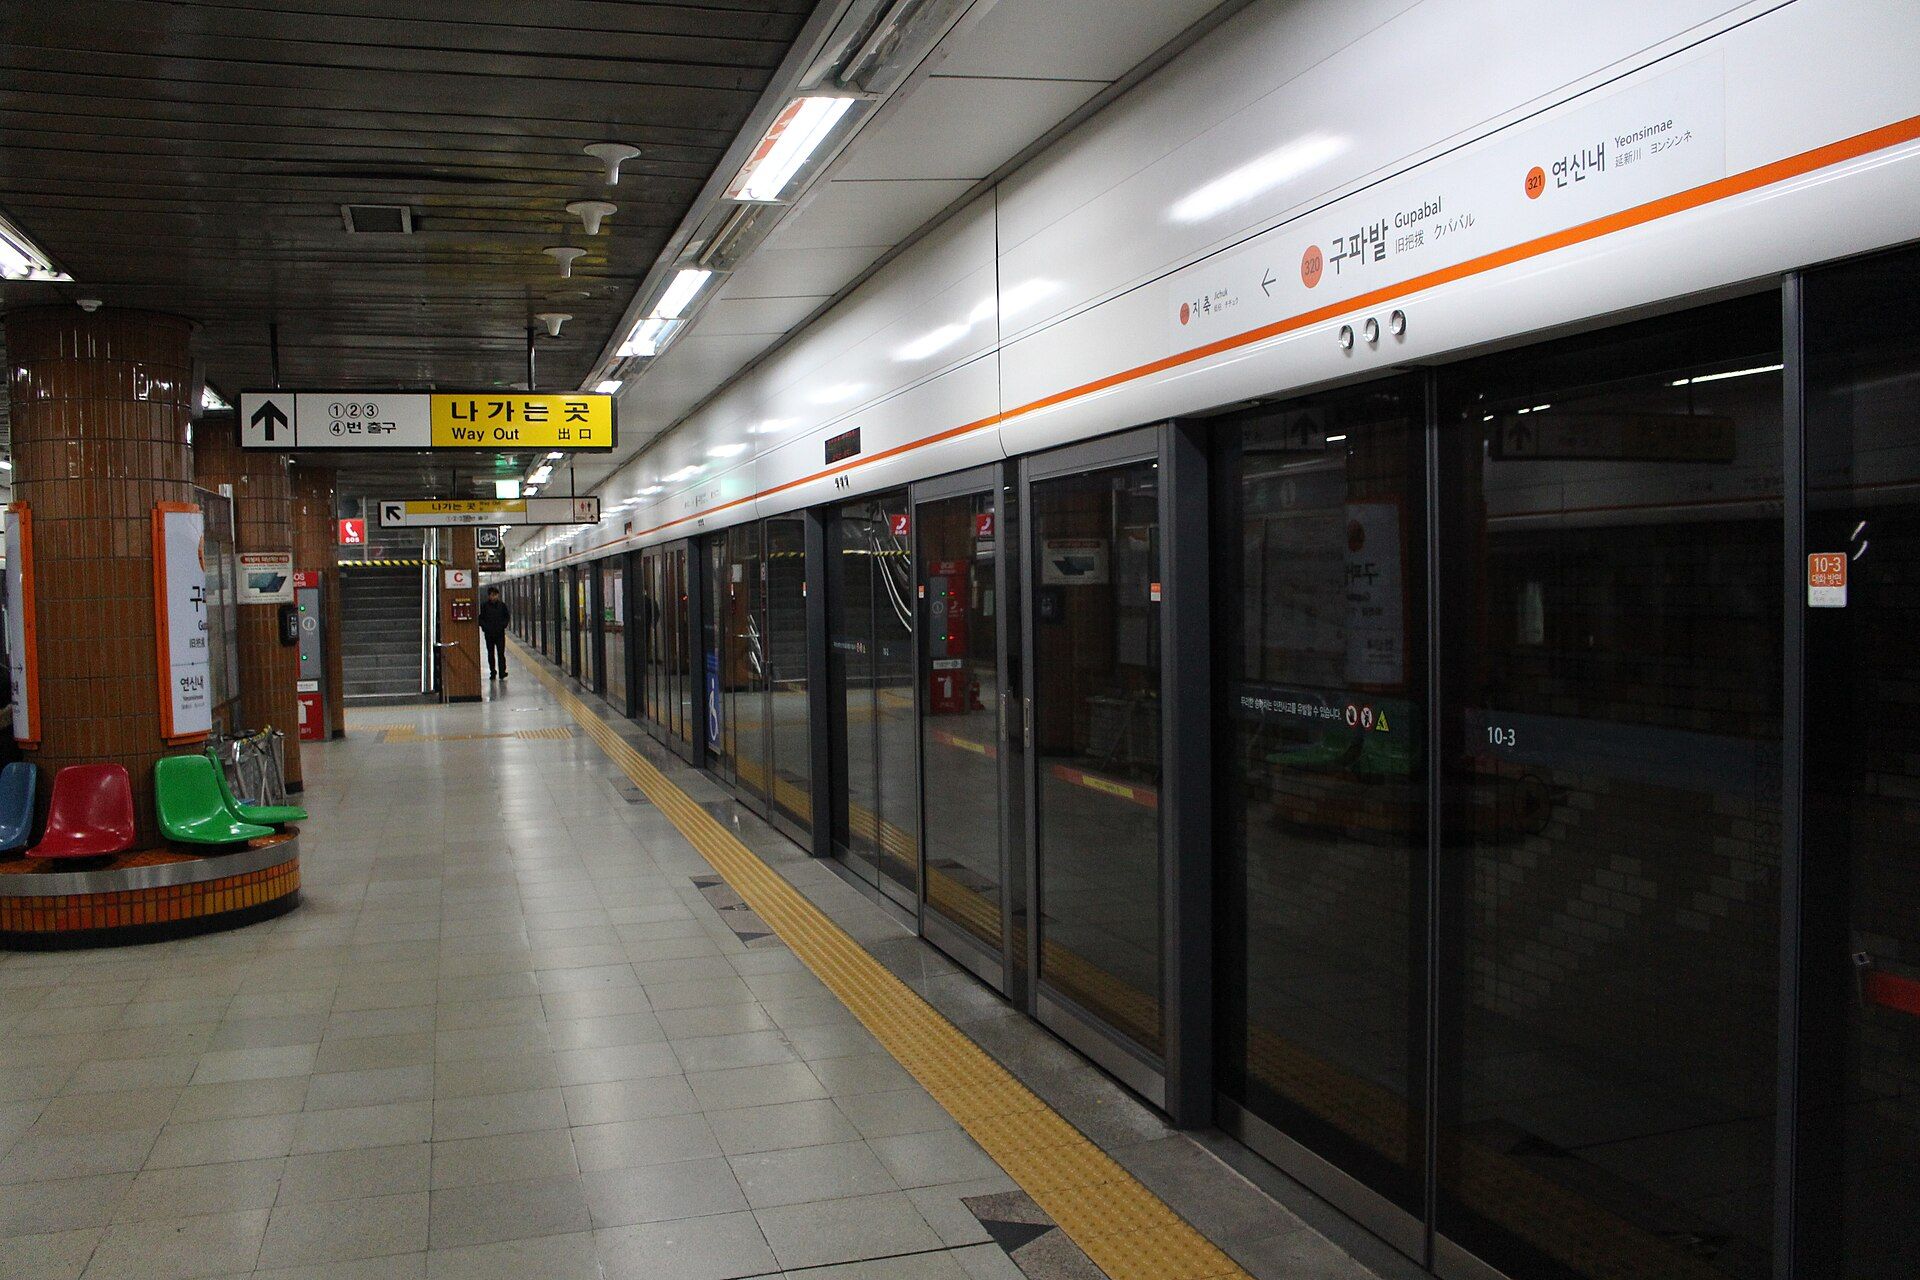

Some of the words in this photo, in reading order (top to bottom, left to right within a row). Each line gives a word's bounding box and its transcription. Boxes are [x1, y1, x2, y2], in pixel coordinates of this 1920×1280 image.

[1614, 119, 1673, 148] Yeonsinnae
[1650, 130, 1692, 154] ヨンシンネ
[1527, 175, 1542, 190] 321
[1552, 142, 1605, 188] 연신내
[1394, 195, 1442, 228] Gupabal
[1304, 256, 1320, 276] 320
[1329, 218, 1389, 275] 구파발
[1193, 295, 1211, 318] 지축
[451, 400, 549, 422] 나가는
[564, 402, 590, 422] 곳
[368, 421, 397, 434] 출구
[452, 428, 484, 442] Way
[494, 427, 520, 441] Out
[558, 428, 592, 441] 出口
[345, 536, 360, 544] SOS
[1814, 556, 1841, 572] 10-3
[294, 573, 305, 581] OS
[453, 572, 464, 583] C
[180, 674, 204, 692] 연신내
[1487, 726, 1516, 747] 10-3
